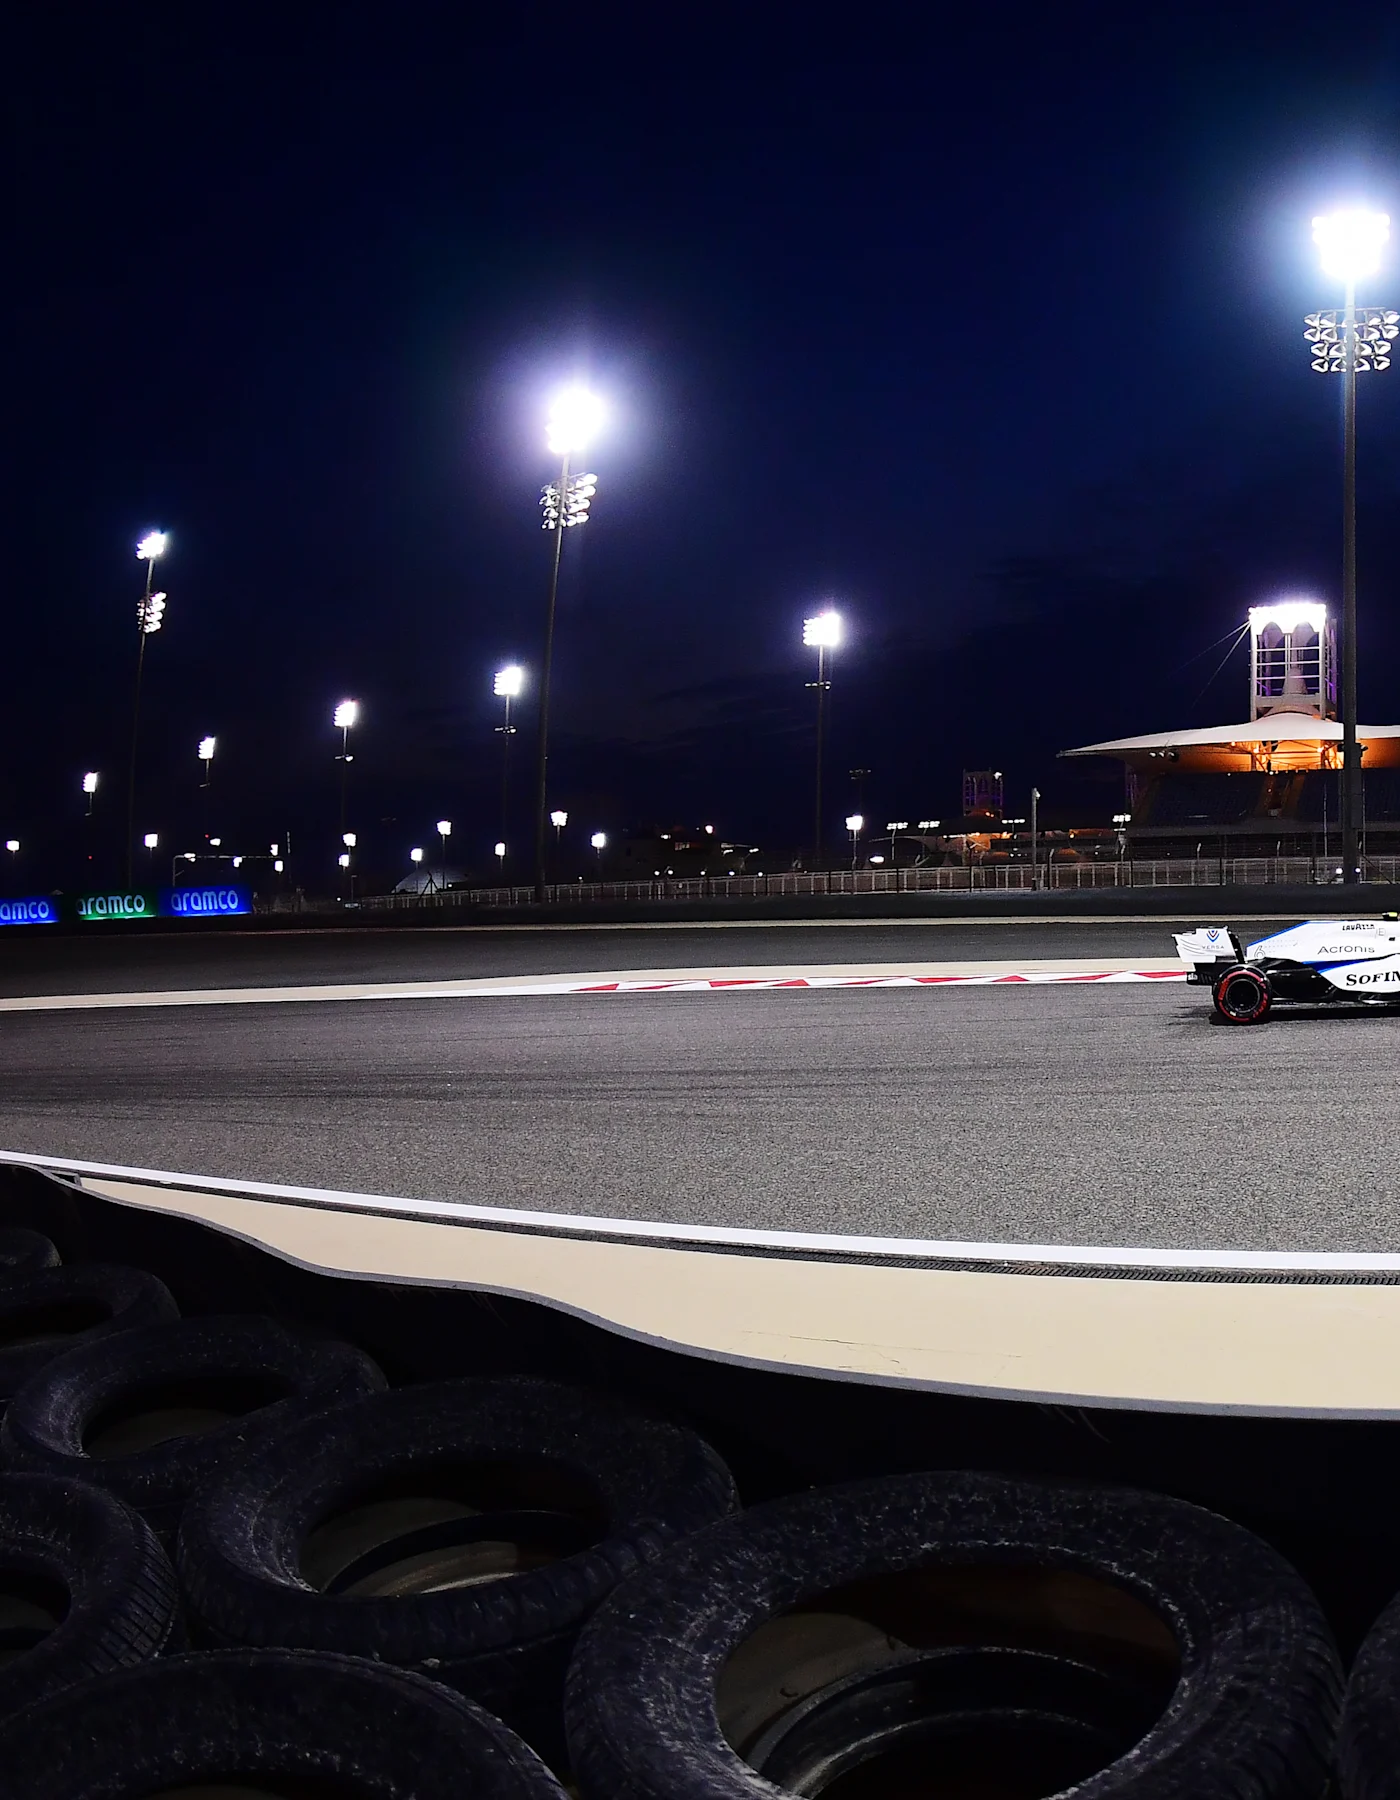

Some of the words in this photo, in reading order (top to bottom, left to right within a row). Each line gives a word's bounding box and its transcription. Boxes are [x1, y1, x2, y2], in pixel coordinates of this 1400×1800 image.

[77, 894, 145, 916] aramco
[171, 889, 239, 911] aramco
[1254, 945, 1266, 958] 6
[1317, 945, 1376, 955] Acronis
